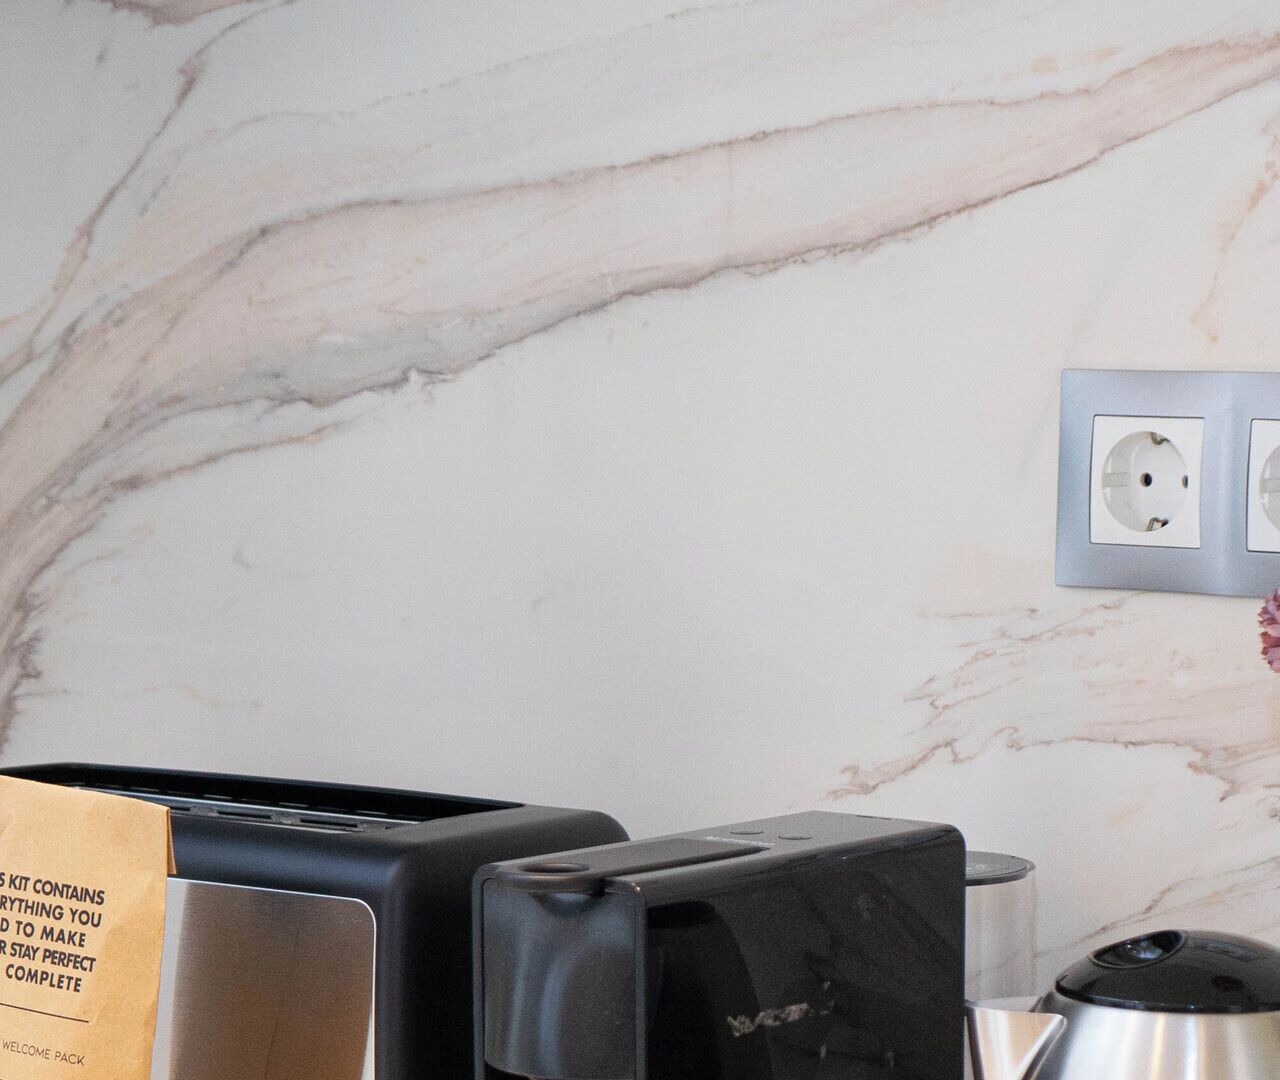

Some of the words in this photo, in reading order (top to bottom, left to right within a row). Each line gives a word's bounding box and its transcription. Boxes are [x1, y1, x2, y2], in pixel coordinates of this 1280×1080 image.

[9, 874, 30, 891] KIT
[34, 879, 105, 905] CONTAINS
[69, 908, 102, 927] YOU
[16, 921, 34, 937] TO
[41, 926, 86, 948] MAKE
[10, 942, 40, 961] STAY
[43, 949, 96, 972] PERFECT
[5, 964, 82, 993] COMPLETE
[3, 1040, 51, 1059] WELCOME
[54, 1051, 85, 1066] PACK
